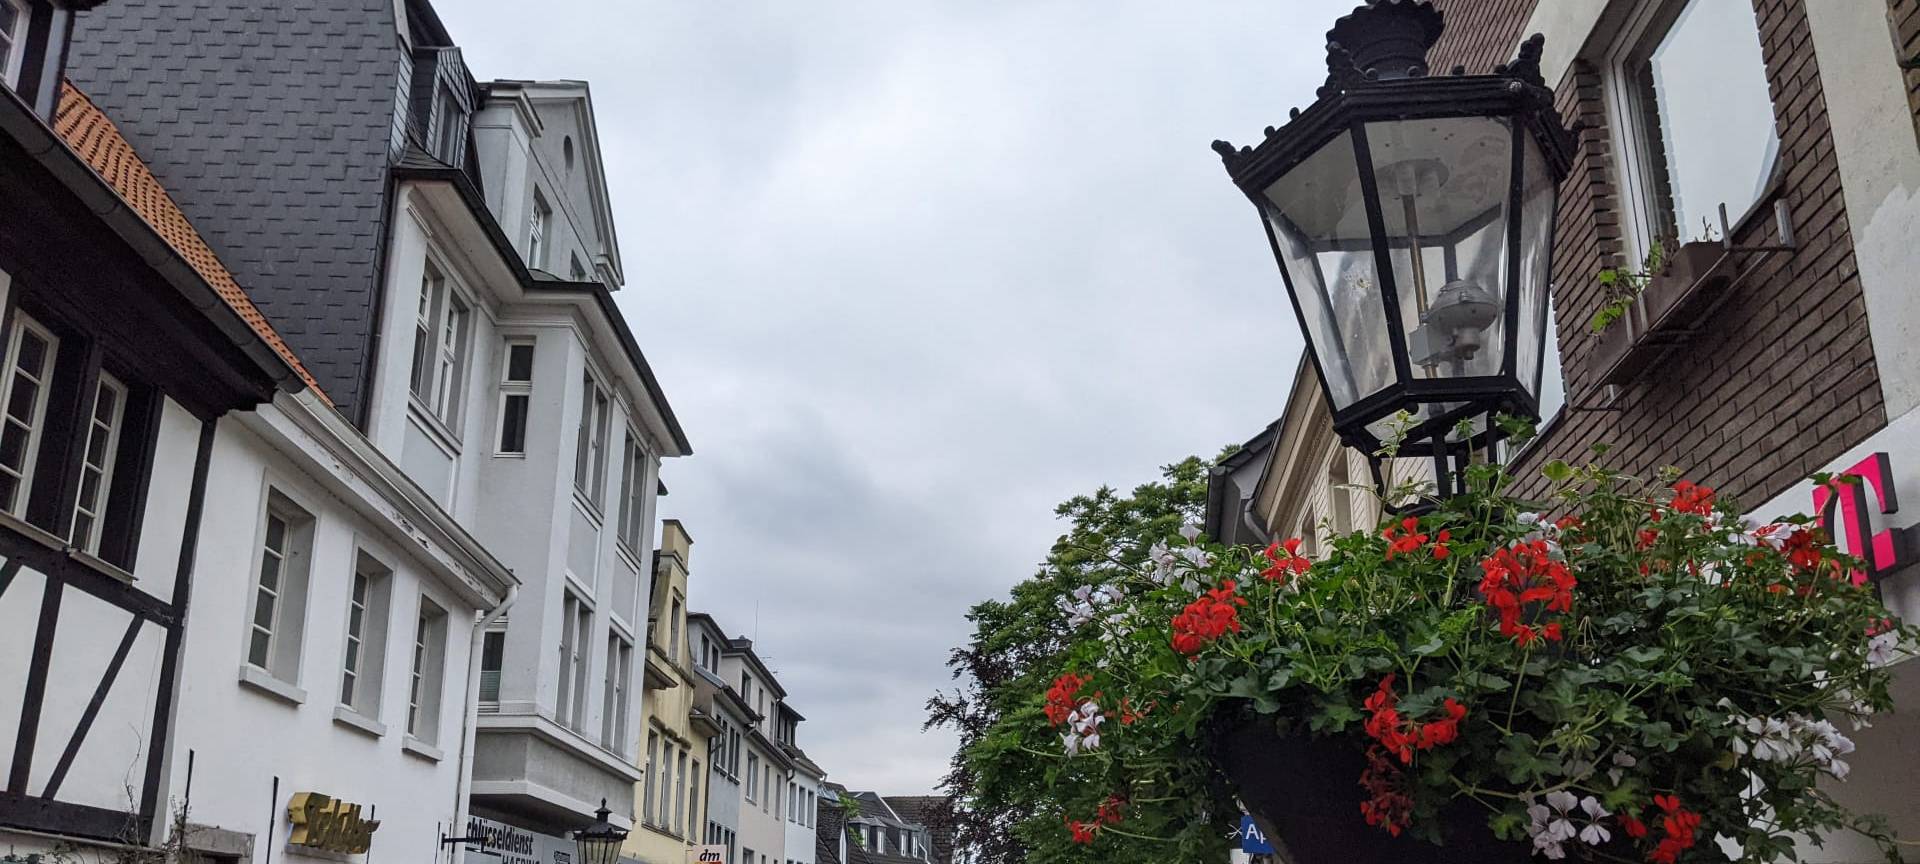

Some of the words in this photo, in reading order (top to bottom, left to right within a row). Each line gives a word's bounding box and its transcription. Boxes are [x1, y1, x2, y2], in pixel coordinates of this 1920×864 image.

[1812, 452, 1898, 590] T
[466, 817, 535, 856] chlüsseldienst
[699, 848, 721, 862] dm
